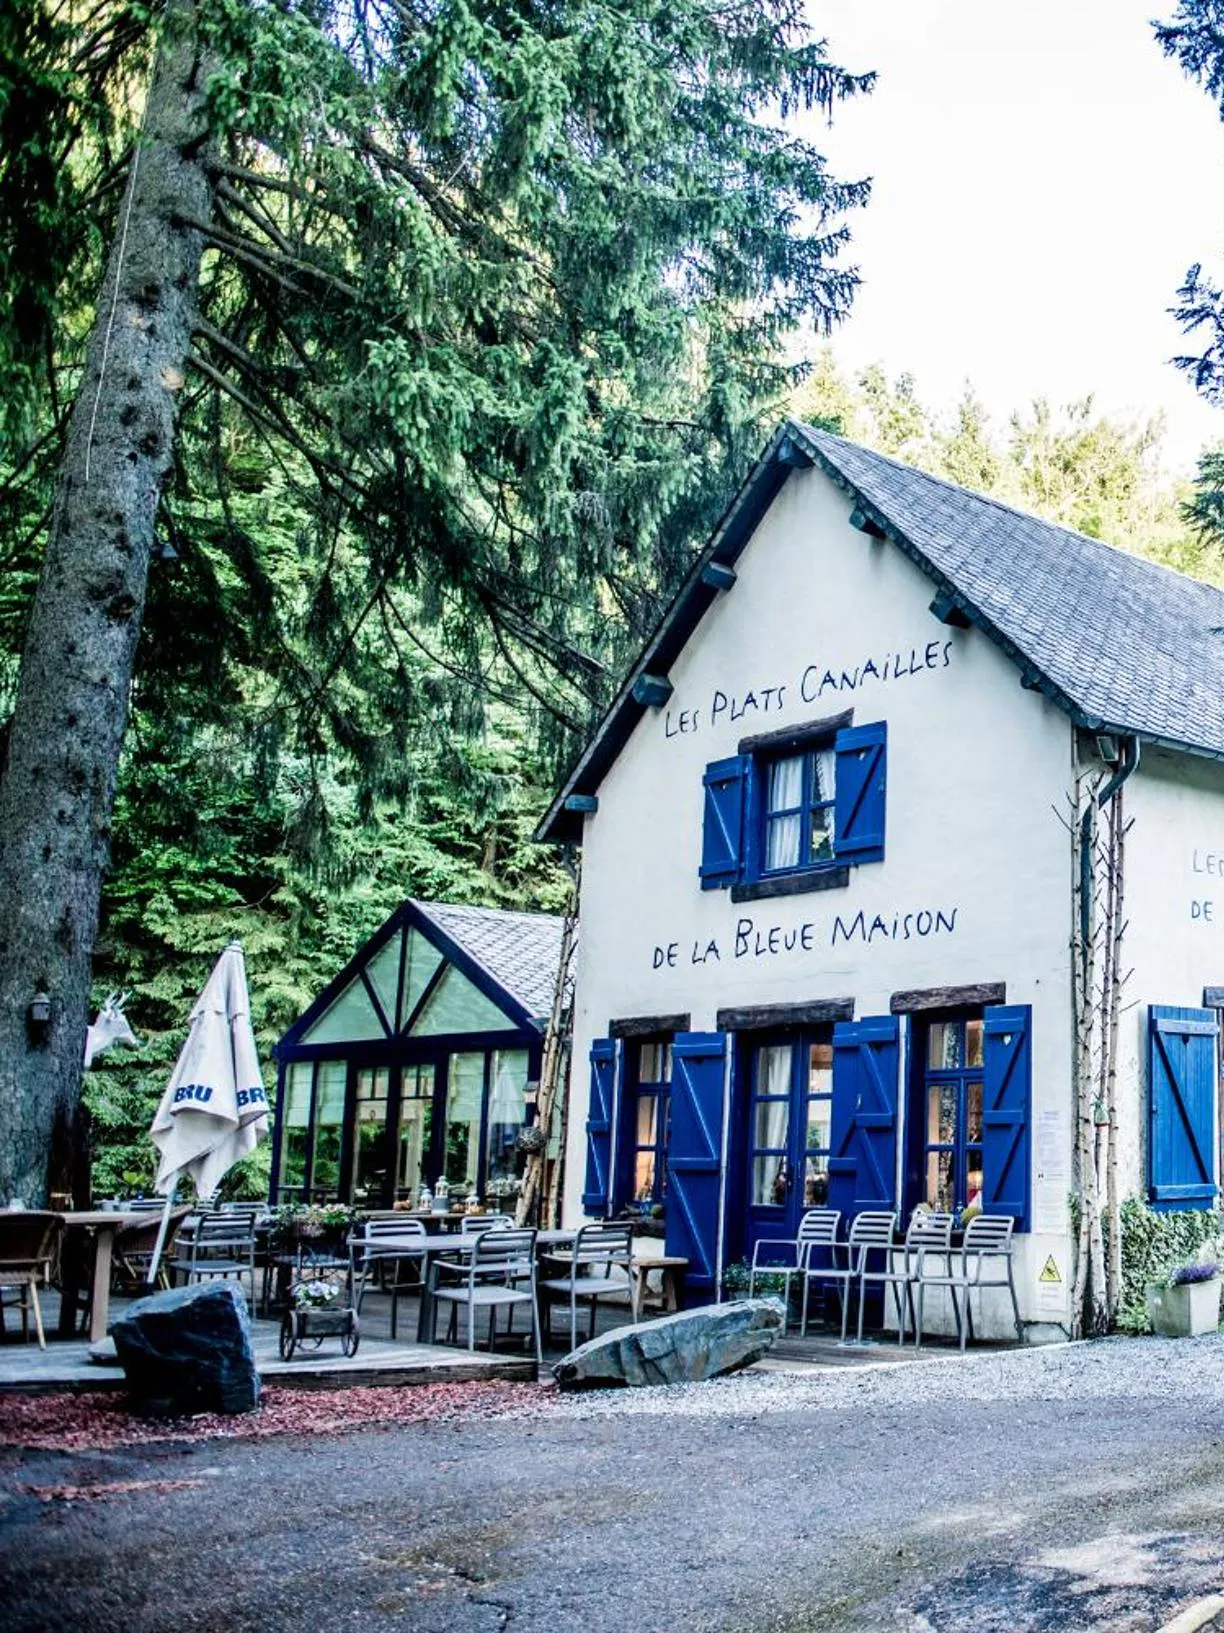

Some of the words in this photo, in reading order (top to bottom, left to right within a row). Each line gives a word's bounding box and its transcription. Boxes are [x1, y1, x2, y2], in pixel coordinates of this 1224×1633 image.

[665, 710, 698, 738] LES
[711, 686, 787, 727] PLATS
[1192, 849, 1224, 877] LES
[1191, 900, 1213, 922] DE
[652, 943, 679, 970] DE
[691, 938, 720, 964] LA
[734, 918, 815, 958] BLEUE
[174, 1084, 213, 1103] BRU
[236, 1087, 265, 1107] BR
